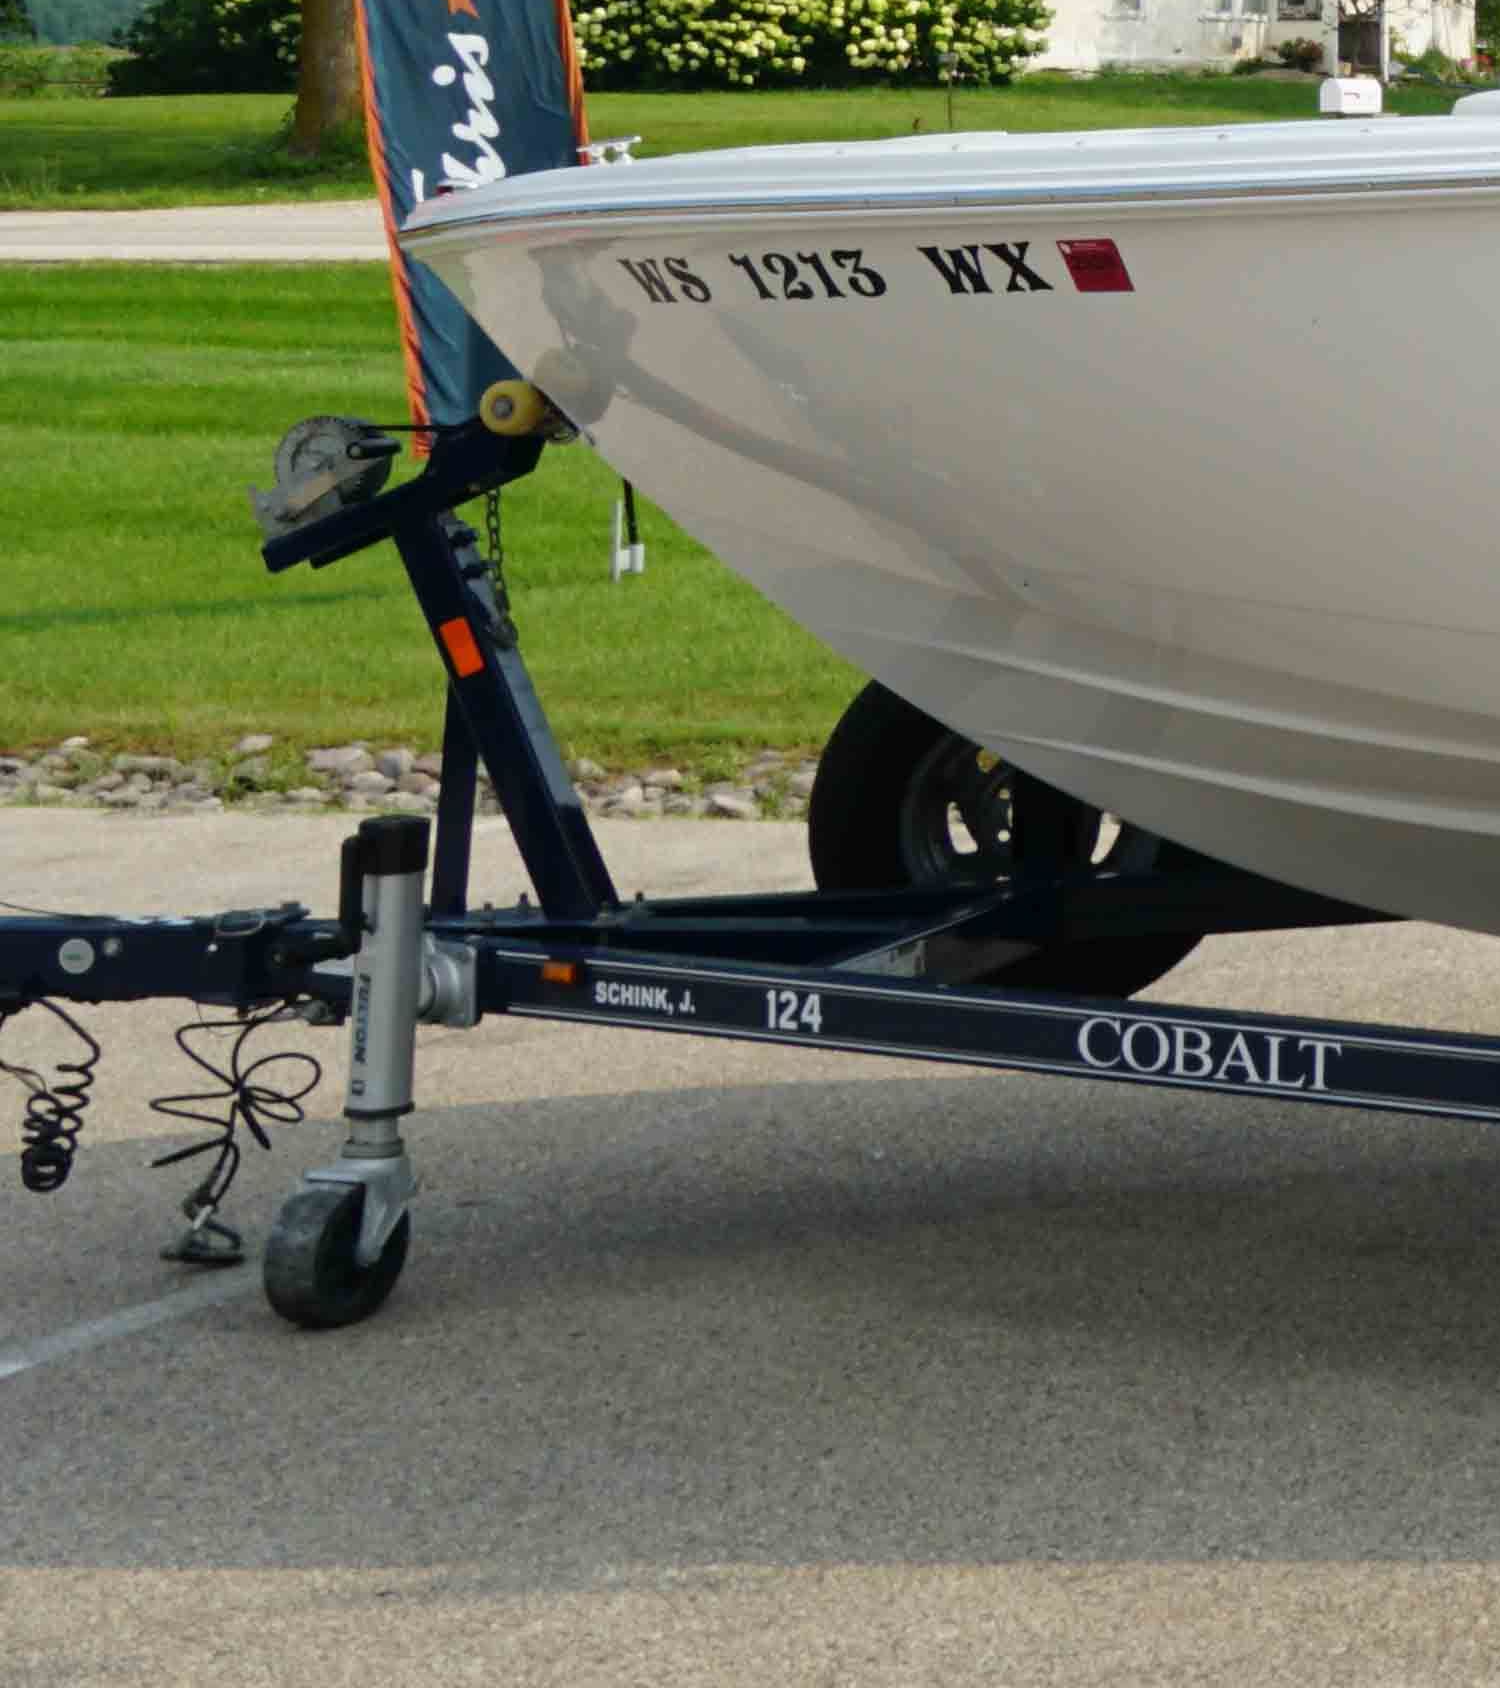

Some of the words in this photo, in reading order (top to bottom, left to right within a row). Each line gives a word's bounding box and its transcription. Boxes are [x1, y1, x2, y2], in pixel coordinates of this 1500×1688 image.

[411, 32, 506, 203] hris
[618, 256, 713, 304] WS
[729, 248, 888, 300] 1213
[917, 241, 1054, 294] WX
[594, 980, 674, 1015] SCHINK,
[679, 989, 697, 1015] J.
[765, 989, 823, 1033] 124
[1077, 1017, 1343, 1091] COBALT
